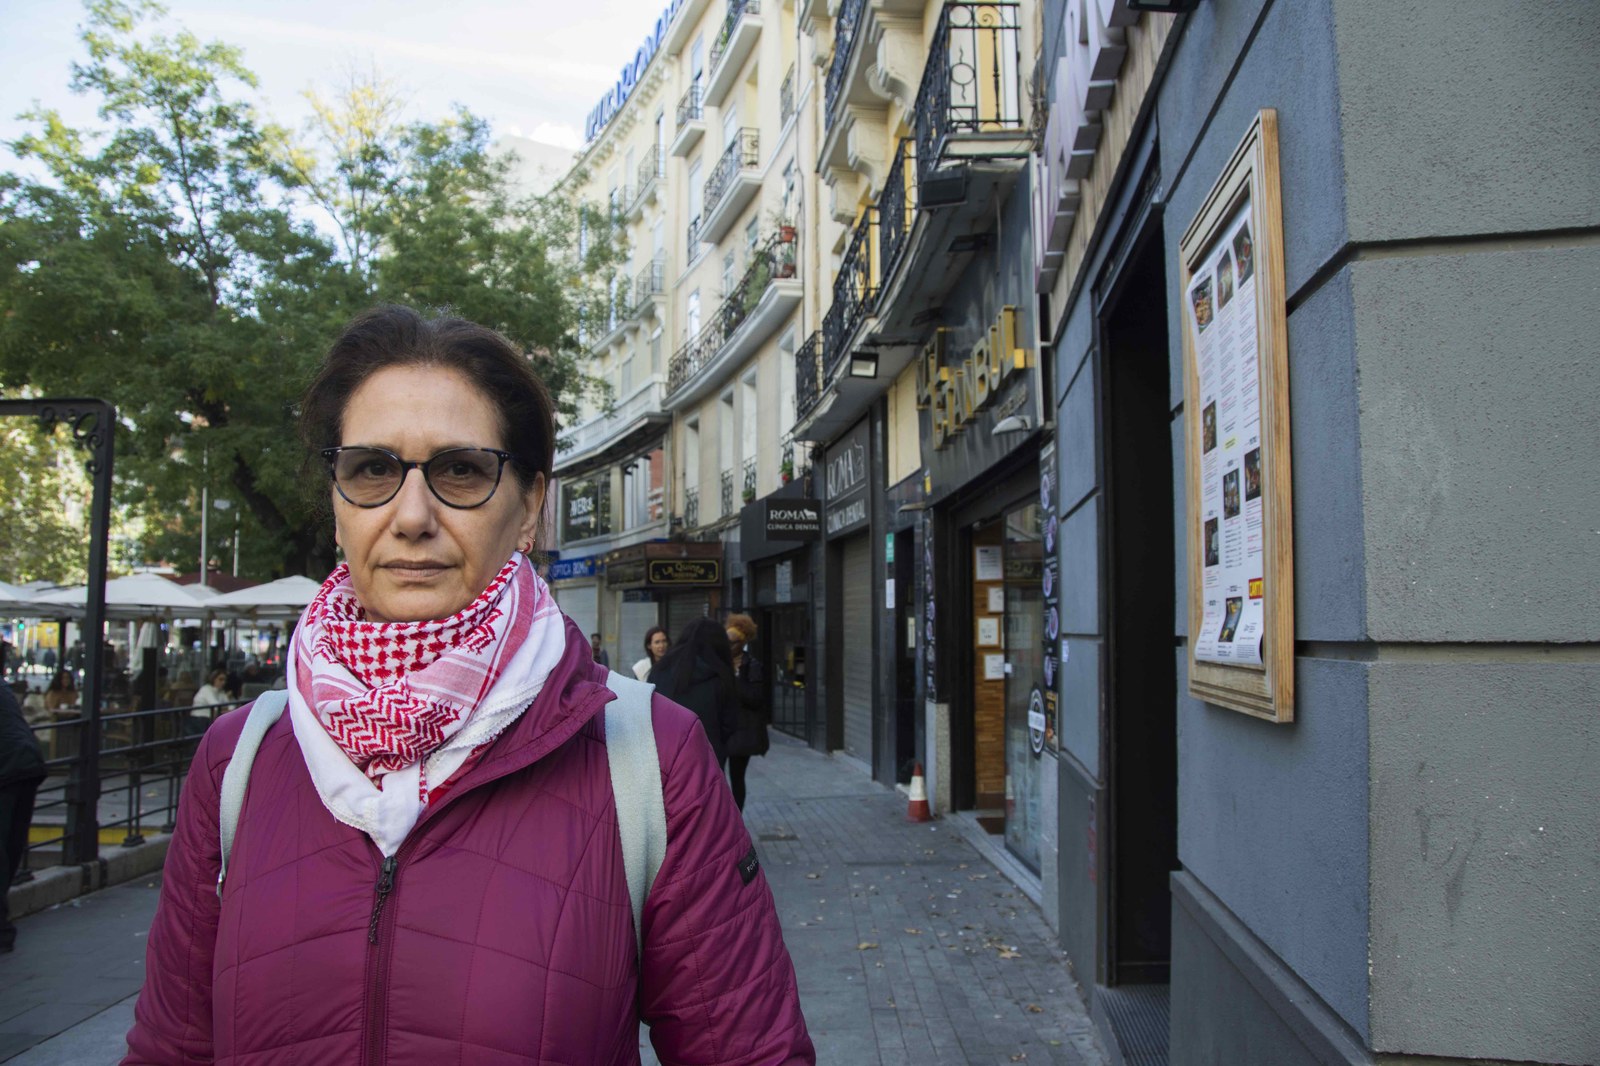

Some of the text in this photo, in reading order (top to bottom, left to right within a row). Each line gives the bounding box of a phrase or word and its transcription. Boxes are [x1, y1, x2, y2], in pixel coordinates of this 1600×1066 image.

[827, 448, 855, 500] ROMA
[769, 509, 806, 520] ROMA
[795, 523, 819, 531] DENTAL
